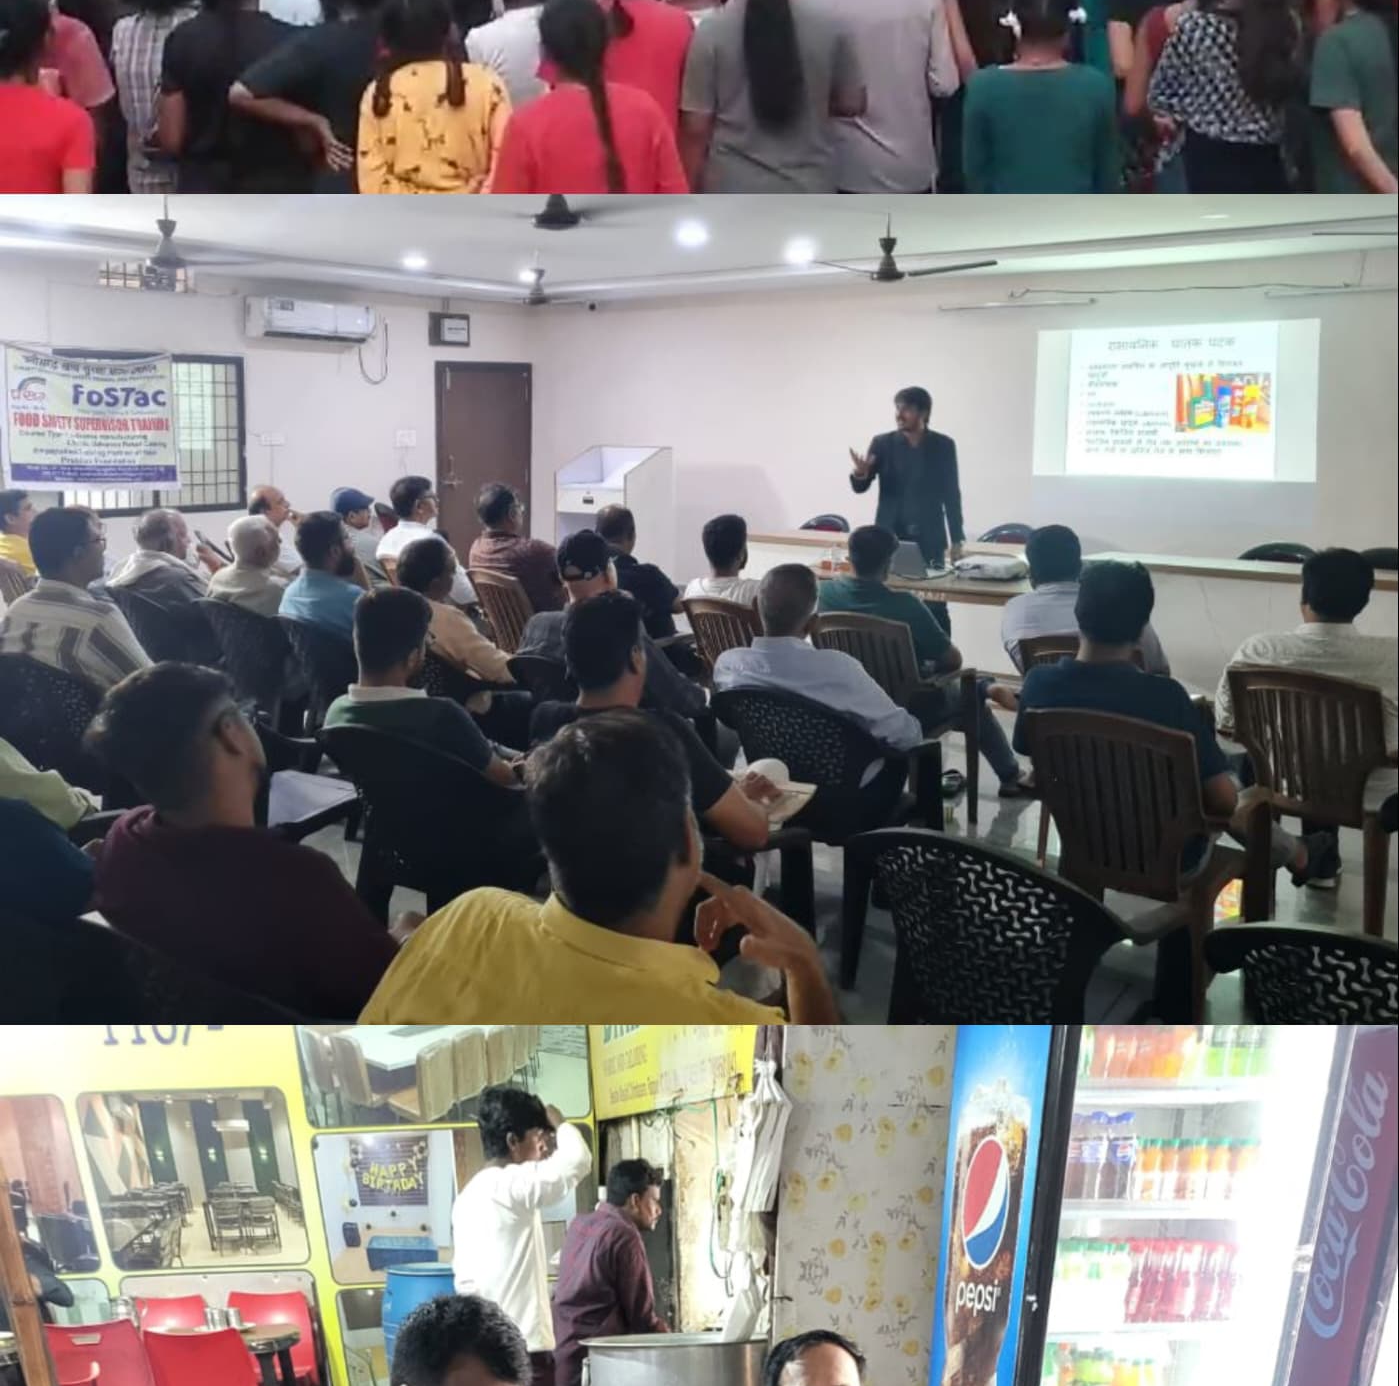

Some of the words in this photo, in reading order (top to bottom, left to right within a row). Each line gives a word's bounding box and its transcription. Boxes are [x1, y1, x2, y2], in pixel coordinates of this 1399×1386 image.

[14, 412, 40, 428] FOOD
[42, 414, 73, 430] SAFETY
[74, 416, 130, 432] SUPERVISOR
[369, 1156, 417, 1178] HAPPY
[362, 1171, 424, 1195] BIRTHDAY
[955, 1278, 999, 1317] pepsi
